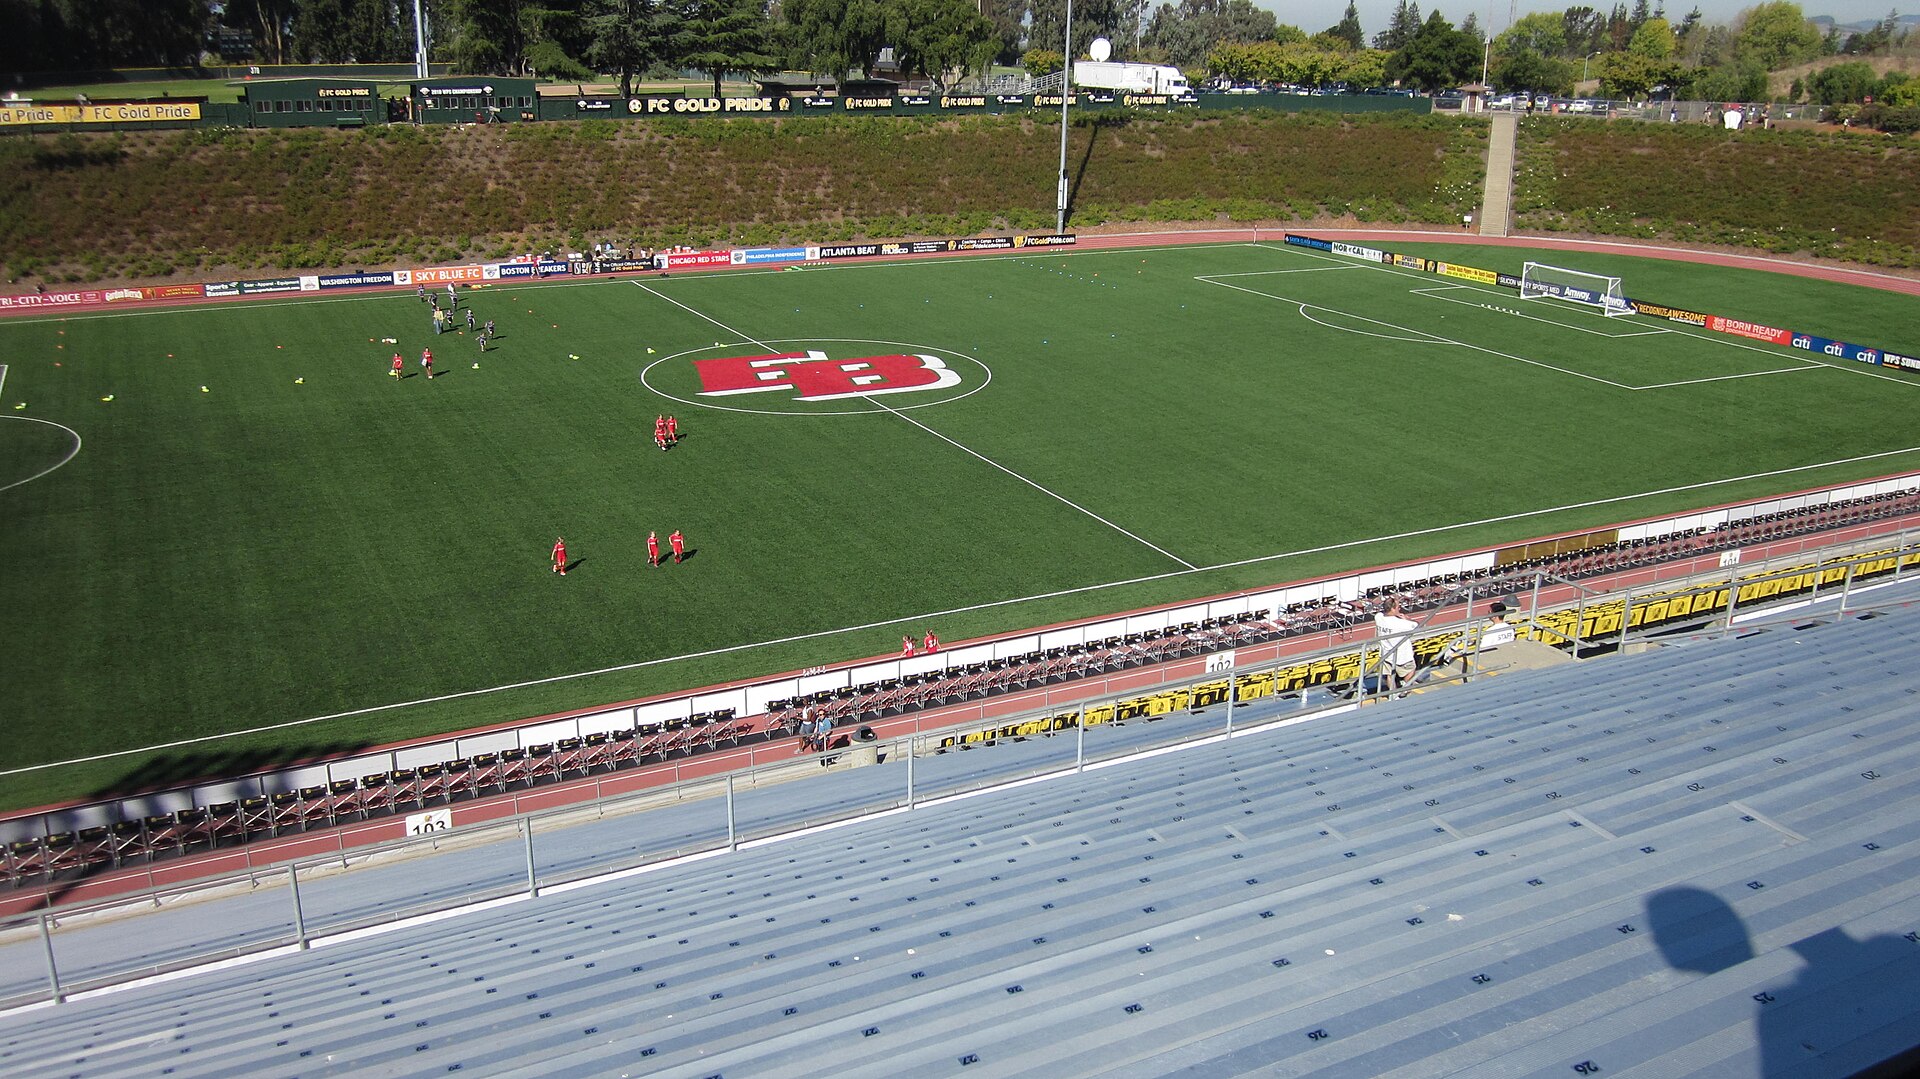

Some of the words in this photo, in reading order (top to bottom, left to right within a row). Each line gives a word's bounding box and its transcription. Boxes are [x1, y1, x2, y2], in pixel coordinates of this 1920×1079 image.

[326, 89, 334, 97] FC
[335, 88, 352, 97] GOLD
[352, 88, 370, 97] PRIDE
[647, 99, 670, 113] FC
[674, 99, 721, 113] GOLD
[725, 97, 773, 112] PRIDE
[855, 98, 862, 107] FC
[863, 98, 877, 107] GOLD
[877, 98, 892, 107] PRIDE
[950, 97, 957, 105] FC
[957, 97, 970, 105] GOLD
[970, 97, 985, 105] PRIDE
[1042, 96, 1049, 104] FC
[1132, 96, 1140, 104] FC
[1140, 96, 1152, 104] GOLD
[1152, 96, 1167, 104] PRIDE
[16, 109, 54, 121] Pride
[94, 107, 112, 120] FC
[119, 106, 150, 119] Gold
[155, 105, 192, 118] Pride
[1027, 236, 1075, 246] FCGoldPride.com
[746, 252, 774, 260] PHILADELPHIA
[774, 250, 806, 258] INDEPENDENCE
[821, 247, 857, 257] ATLANTA
[857, 246, 877, 255] BEAT
[1333, 243, 1348, 253] NOR
[1352, 246, 1365, 257] CAL
[668, 256, 697, 265] CHICAGO
[698, 255, 710, 263] RED
[711, 254, 730, 263] STARS
[415, 271, 436, 282] SKY
[439, 270, 465, 280] BLUE
[467, 268, 480, 278] FC
[501, 266, 530, 276] BOSTON
[531, 264, 567, 274] BEAKERS
[205, 283, 228, 291] Sports
[320, 277, 362, 287] WASHINGTON
[363, 275, 392, 284] FREEDOM
[206, 289, 240, 297] Basement
[1726, 319, 1752, 332] BORN
[1752, 325, 1783, 338] READY
[1792, 338, 1810, 350] citi
[1824, 344, 1843, 357] citi
[1856, 351, 1876, 364] citi
[1883, 353, 1901, 365] WPS
[1497, 632, 1513, 641] STAFF
[1209, 659, 1231, 672] 102
[413, 820, 447, 835] 103
